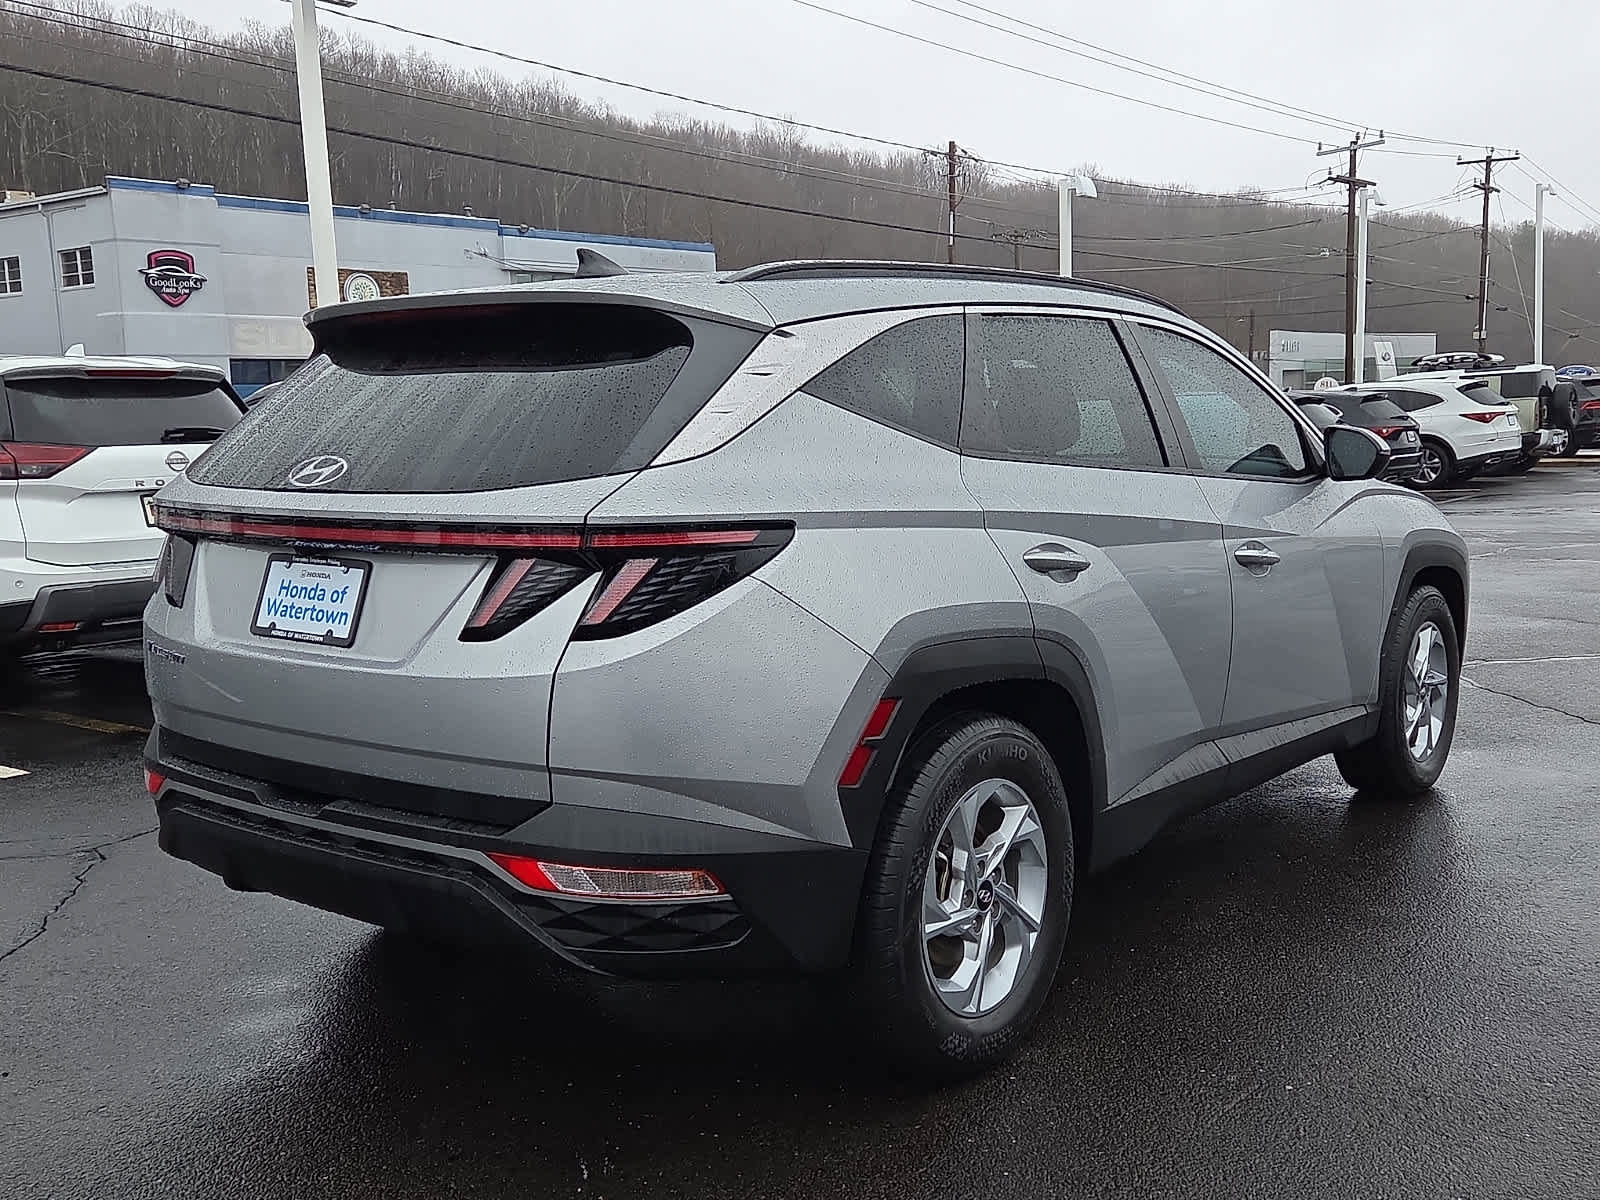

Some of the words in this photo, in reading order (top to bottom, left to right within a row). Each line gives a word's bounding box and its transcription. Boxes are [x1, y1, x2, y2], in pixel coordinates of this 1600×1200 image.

[306, 572, 331, 580] HONDA
[278, 578, 326, 601] Honda
[330, 585, 349, 604] of
[267, 597, 349, 626] Watertown
